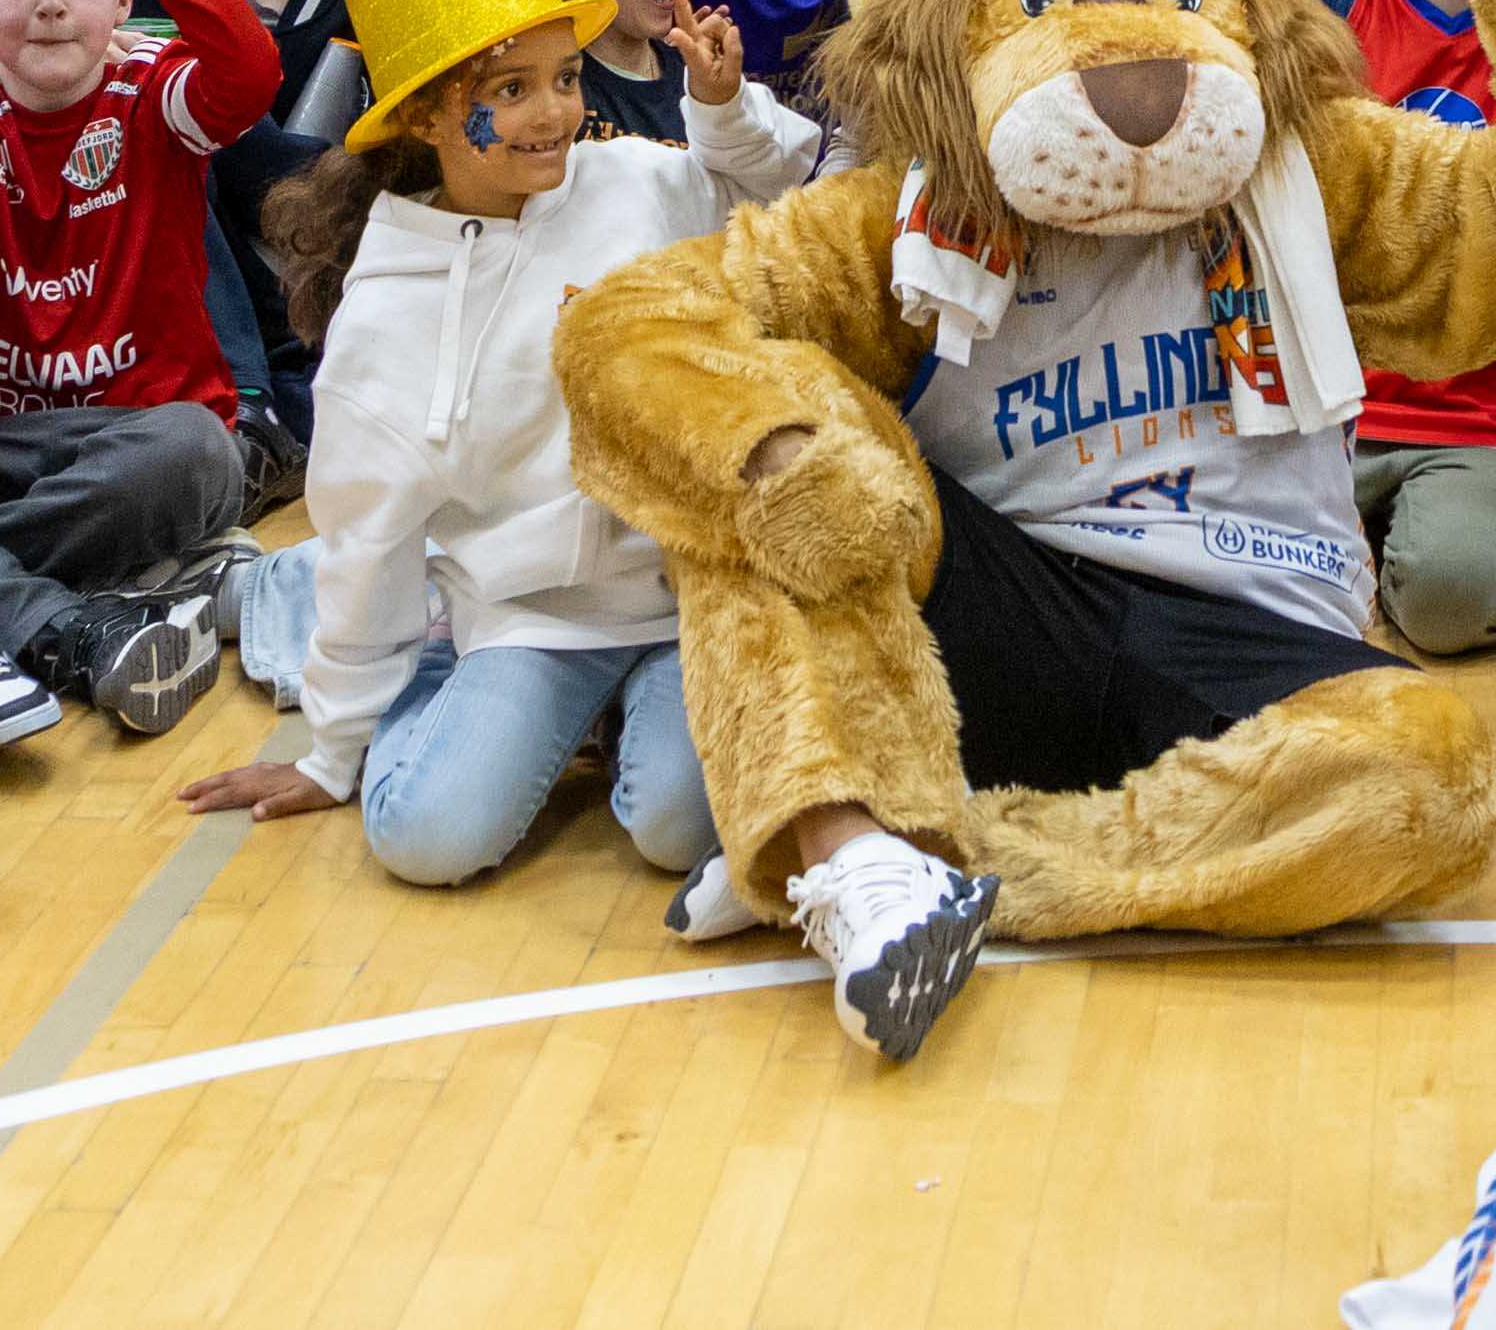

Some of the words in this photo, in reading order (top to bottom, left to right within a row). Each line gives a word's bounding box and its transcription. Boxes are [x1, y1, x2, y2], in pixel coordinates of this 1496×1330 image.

[1017, 289, 1057, 306] WIBO
[1077, 403, 1237, 466] LIONS
[1251, 540, 1346, 582] BUNKERS
